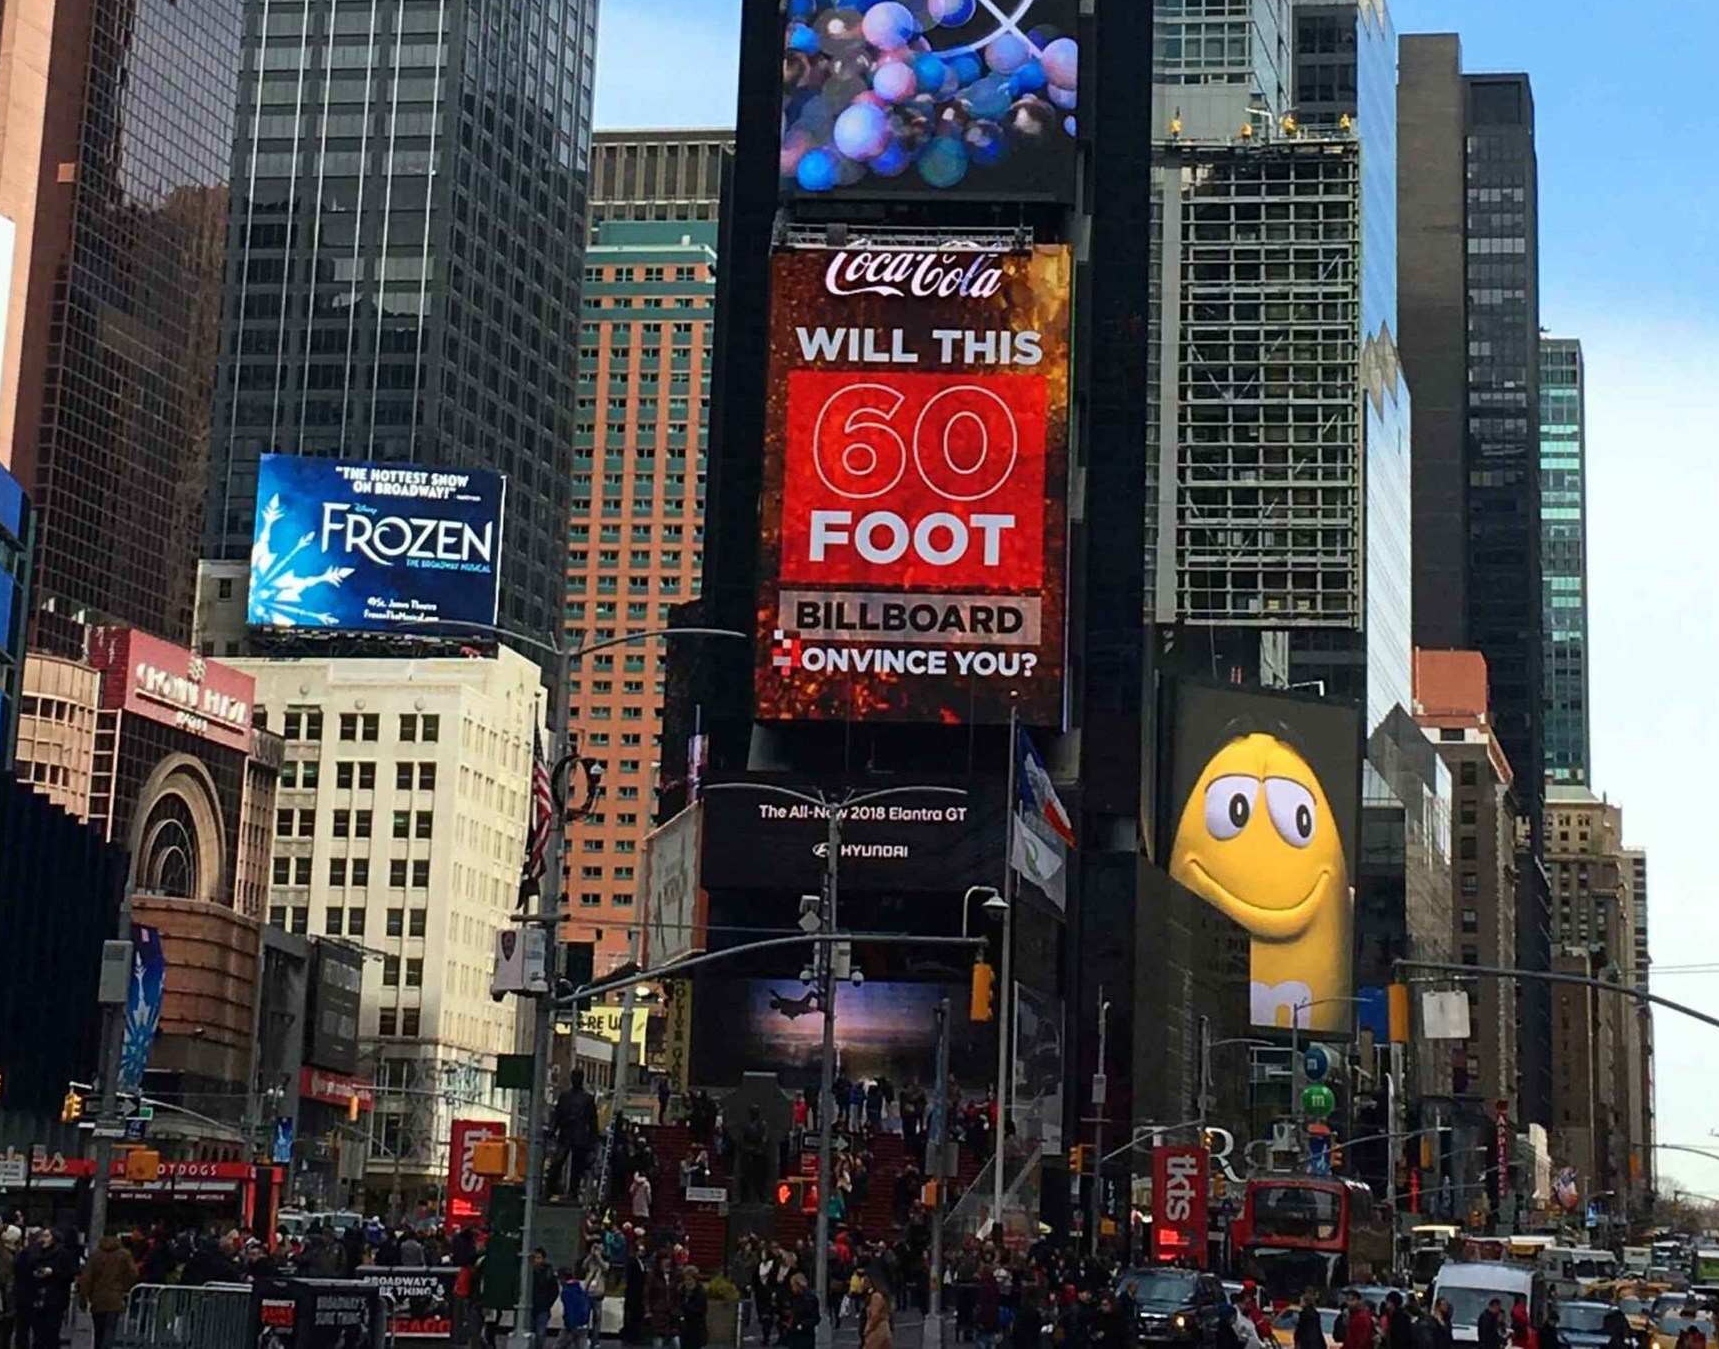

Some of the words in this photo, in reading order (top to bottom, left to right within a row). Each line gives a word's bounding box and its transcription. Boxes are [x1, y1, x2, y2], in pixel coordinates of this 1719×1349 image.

[796, 326, 919, 364] WILL
[932, 329, 1043, 365] THIS
[813, 383, 1018, 501] 60
[352, 481, 372, 493] ON
[370, 469, 430, 484] HOTTEST
[430, 473, 469, 487] SHOW
[321, 502, 493, 566] FROZEN
[808, 510, 1016, 567] FOOT
[795, 600, 1023, 635] BILLBOARD
[801, 646, 947, 676] ONVINCE
[952, 650, 1038, 677] YOU?
[759, 804, 787, 819] The
[850, 806, 886, 820] 2018
[889, 807, 943, 821] Elantra
[945, 808, 968, 822] GT
[841, 845, 909, 858] HYUNDAI
[1166, 1155, 1198, 1221] tkts
